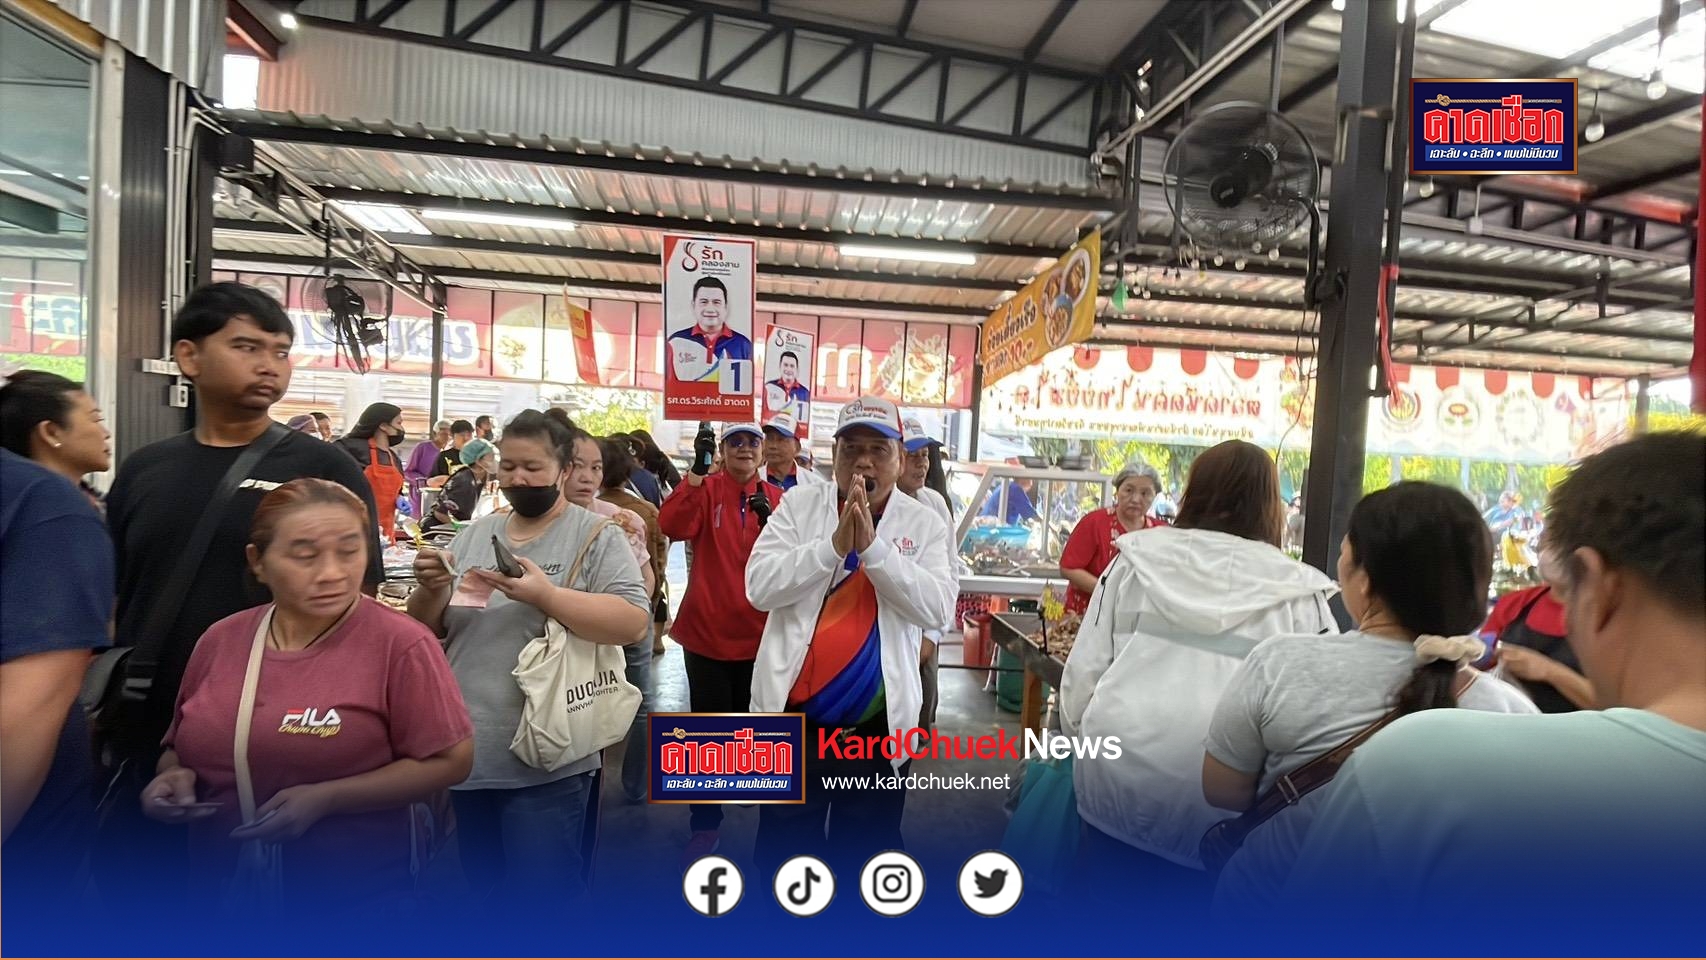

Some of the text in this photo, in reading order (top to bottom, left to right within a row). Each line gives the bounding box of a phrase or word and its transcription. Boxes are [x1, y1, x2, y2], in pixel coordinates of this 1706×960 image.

[701, 245, 723, 260] รัก
[730, 362, 741, 391] 1
[797, 402, 804, 420] 1
[281, 707, 341, 727] FILA
